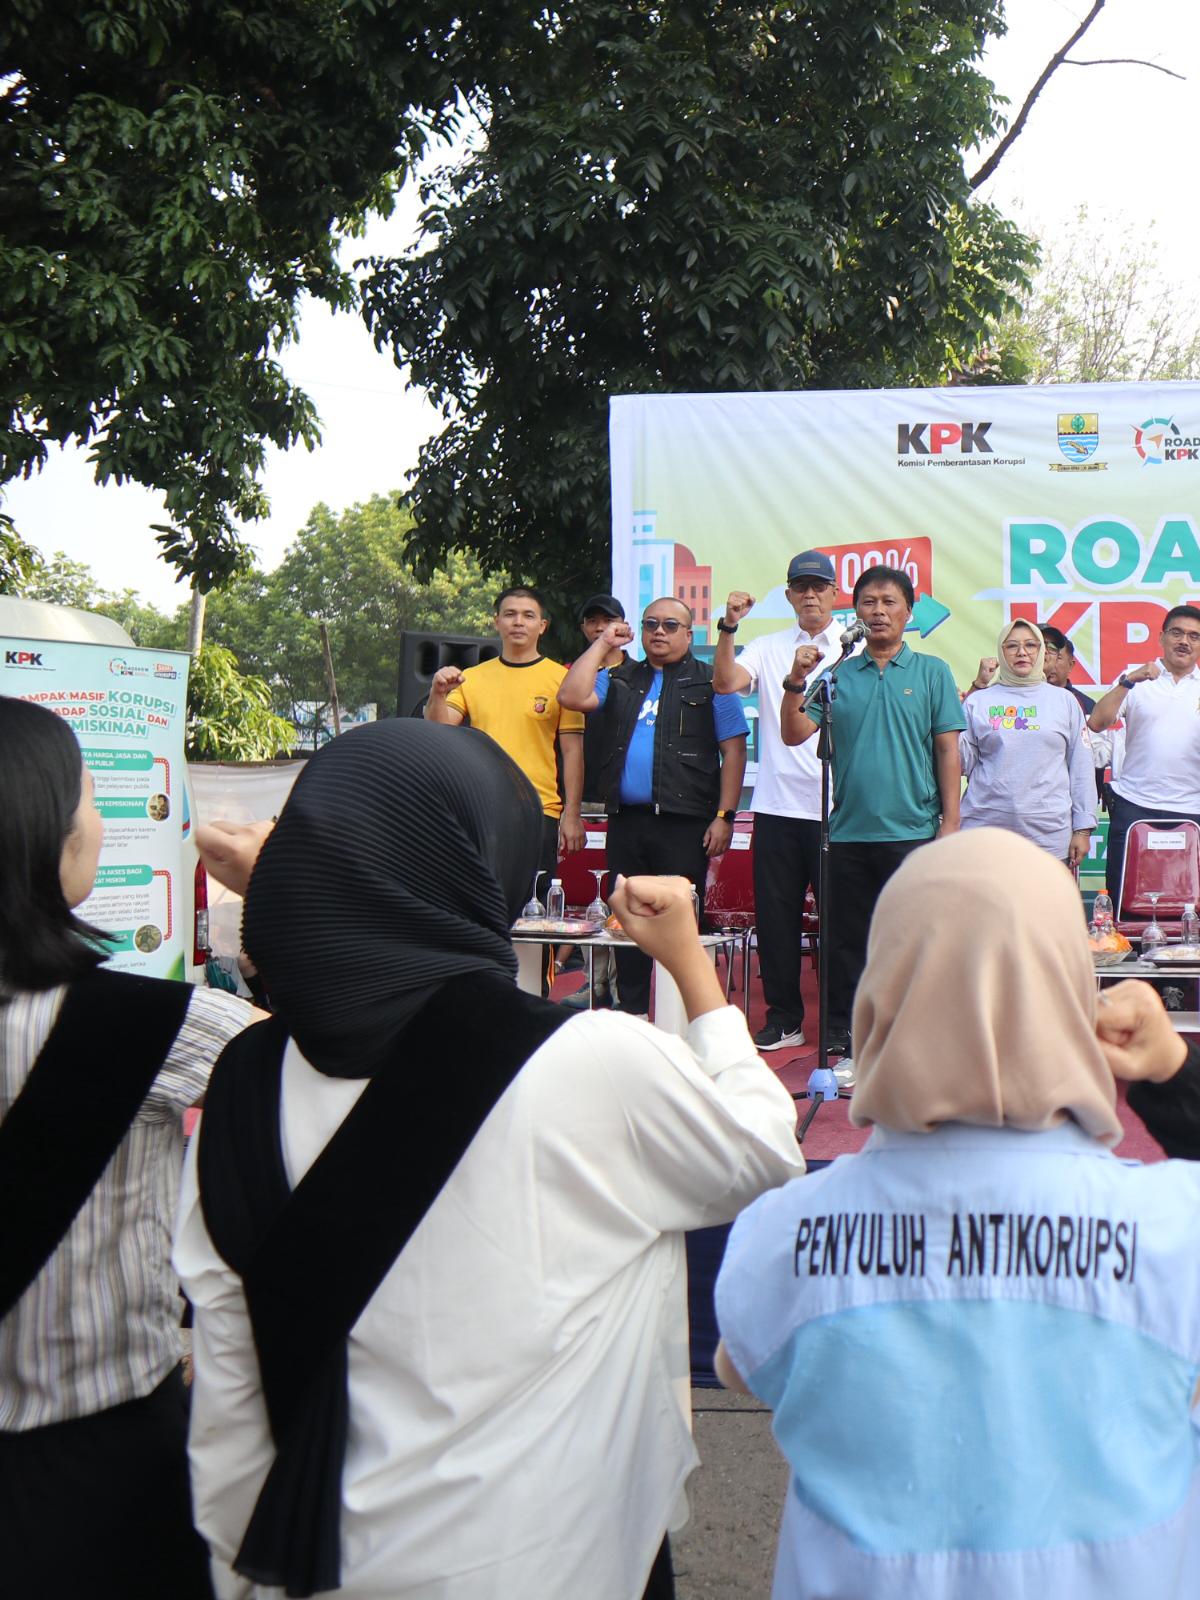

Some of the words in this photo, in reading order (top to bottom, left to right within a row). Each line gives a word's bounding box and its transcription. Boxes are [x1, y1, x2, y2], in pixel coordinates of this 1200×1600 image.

[898, 422, 994, 454] KPK
[898, 459, 925, 467] Komisi
[928, 458, 991, 467] Pemberantasan
[993, 458, 1026, 467] Korupsi
[1165, 448, 1199, 460] KPK
[5, 651, 43, 666] KPK
[20, 691, 66, 703] AMPAK
[69, 691, 105, 701] MASIF
[108, 690, 175, 714] KORUPSI
[89, 704, 145, 721] SOSIAL
[147, 714, 168, 726] DAN
[794, 1213, 926, 1278] PENYULUH
[947, 1213, 1138, 1284] ANTIKORUPSI
